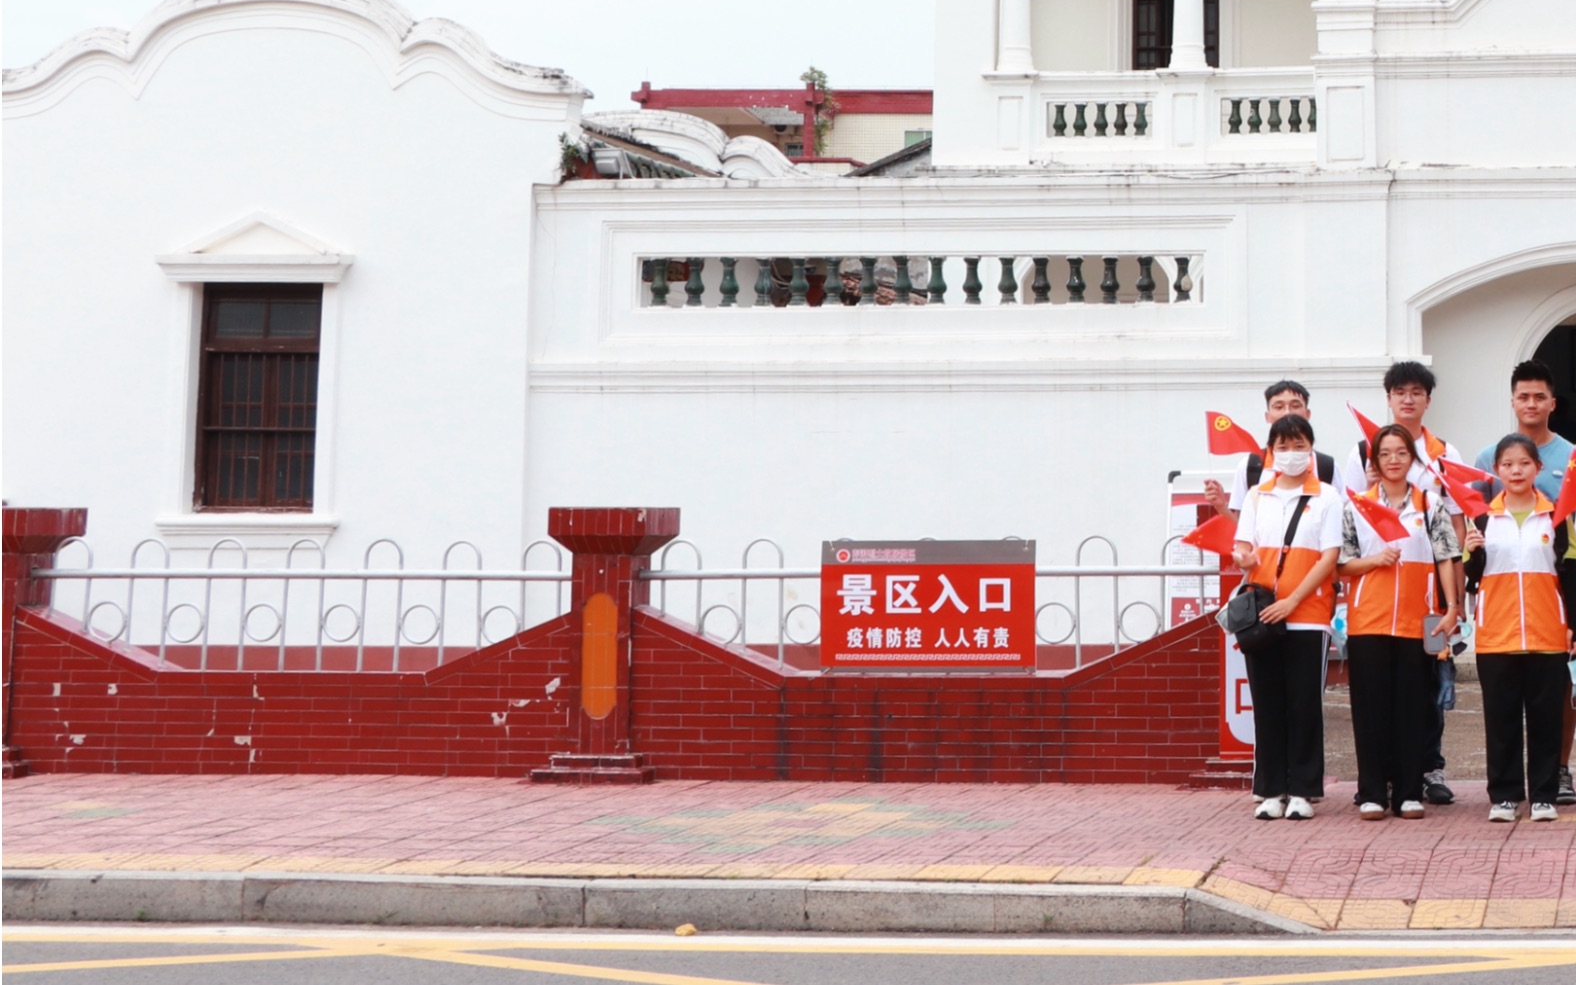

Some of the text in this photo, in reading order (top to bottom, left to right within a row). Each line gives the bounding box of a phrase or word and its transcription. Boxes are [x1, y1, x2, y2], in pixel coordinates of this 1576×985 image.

[836, 574, 1012, 615] 景区入口
[847, 627, 1010, 648] 疫情防控 人人有责
